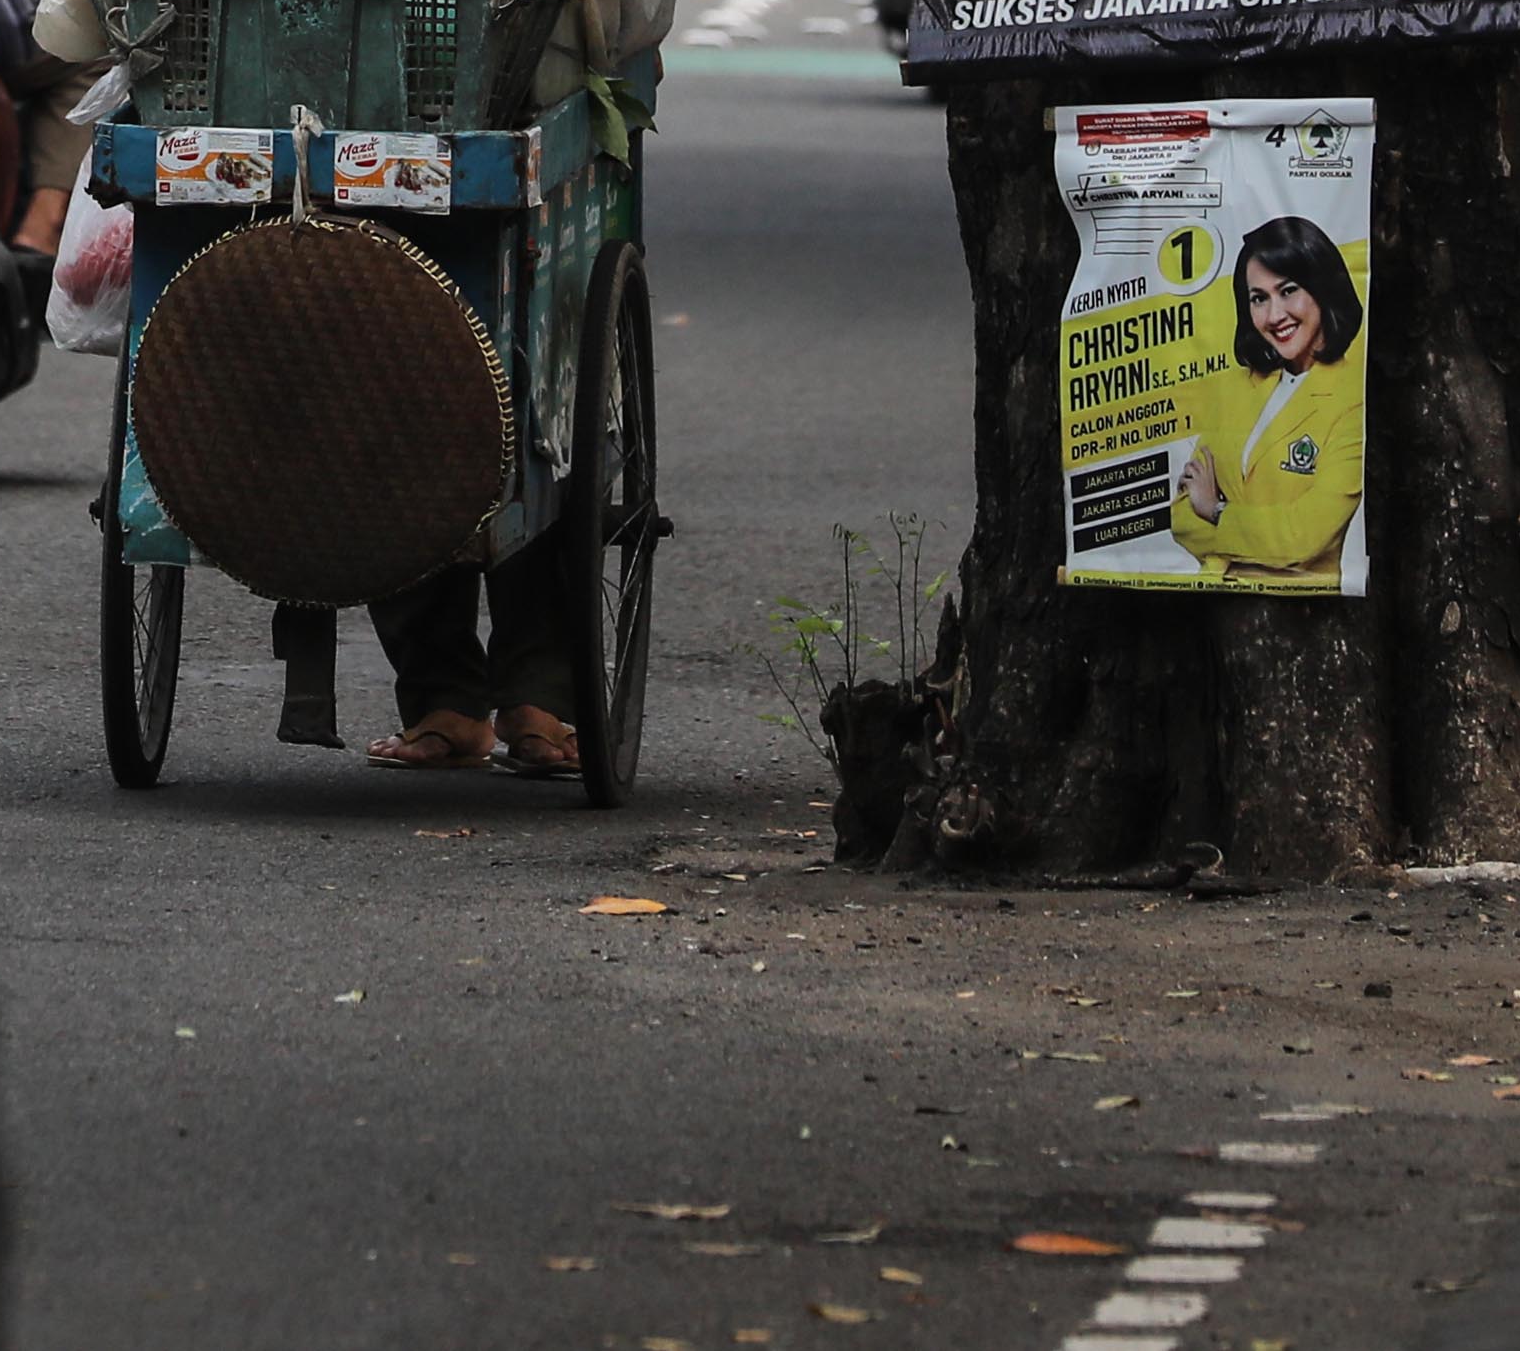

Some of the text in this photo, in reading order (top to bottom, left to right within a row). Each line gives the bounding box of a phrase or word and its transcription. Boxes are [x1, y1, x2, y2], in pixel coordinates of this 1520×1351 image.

[1265, 123, 1287, 148] 4
[1168, 230, 1194, 281] 1
[1070, 276, 1146, 315] KERJA NYATA
[1069, 302, 1194, 369] CHRISTINA
[1070, 353, 1230, 412] ARYANI S.E., S.H., M.H.
[1070, 398, 1176, 438] CALON ANGGOTA
[1071, 419, 1178, 461] DPR-RI NO. URUT
[1084, 461, 1156, 490] JAKARTA PUSAT
[1081, 487, 1165, 519] JAKARTA SELATAN
[1094, 517, 1155, 543] LUAR NEGERI
